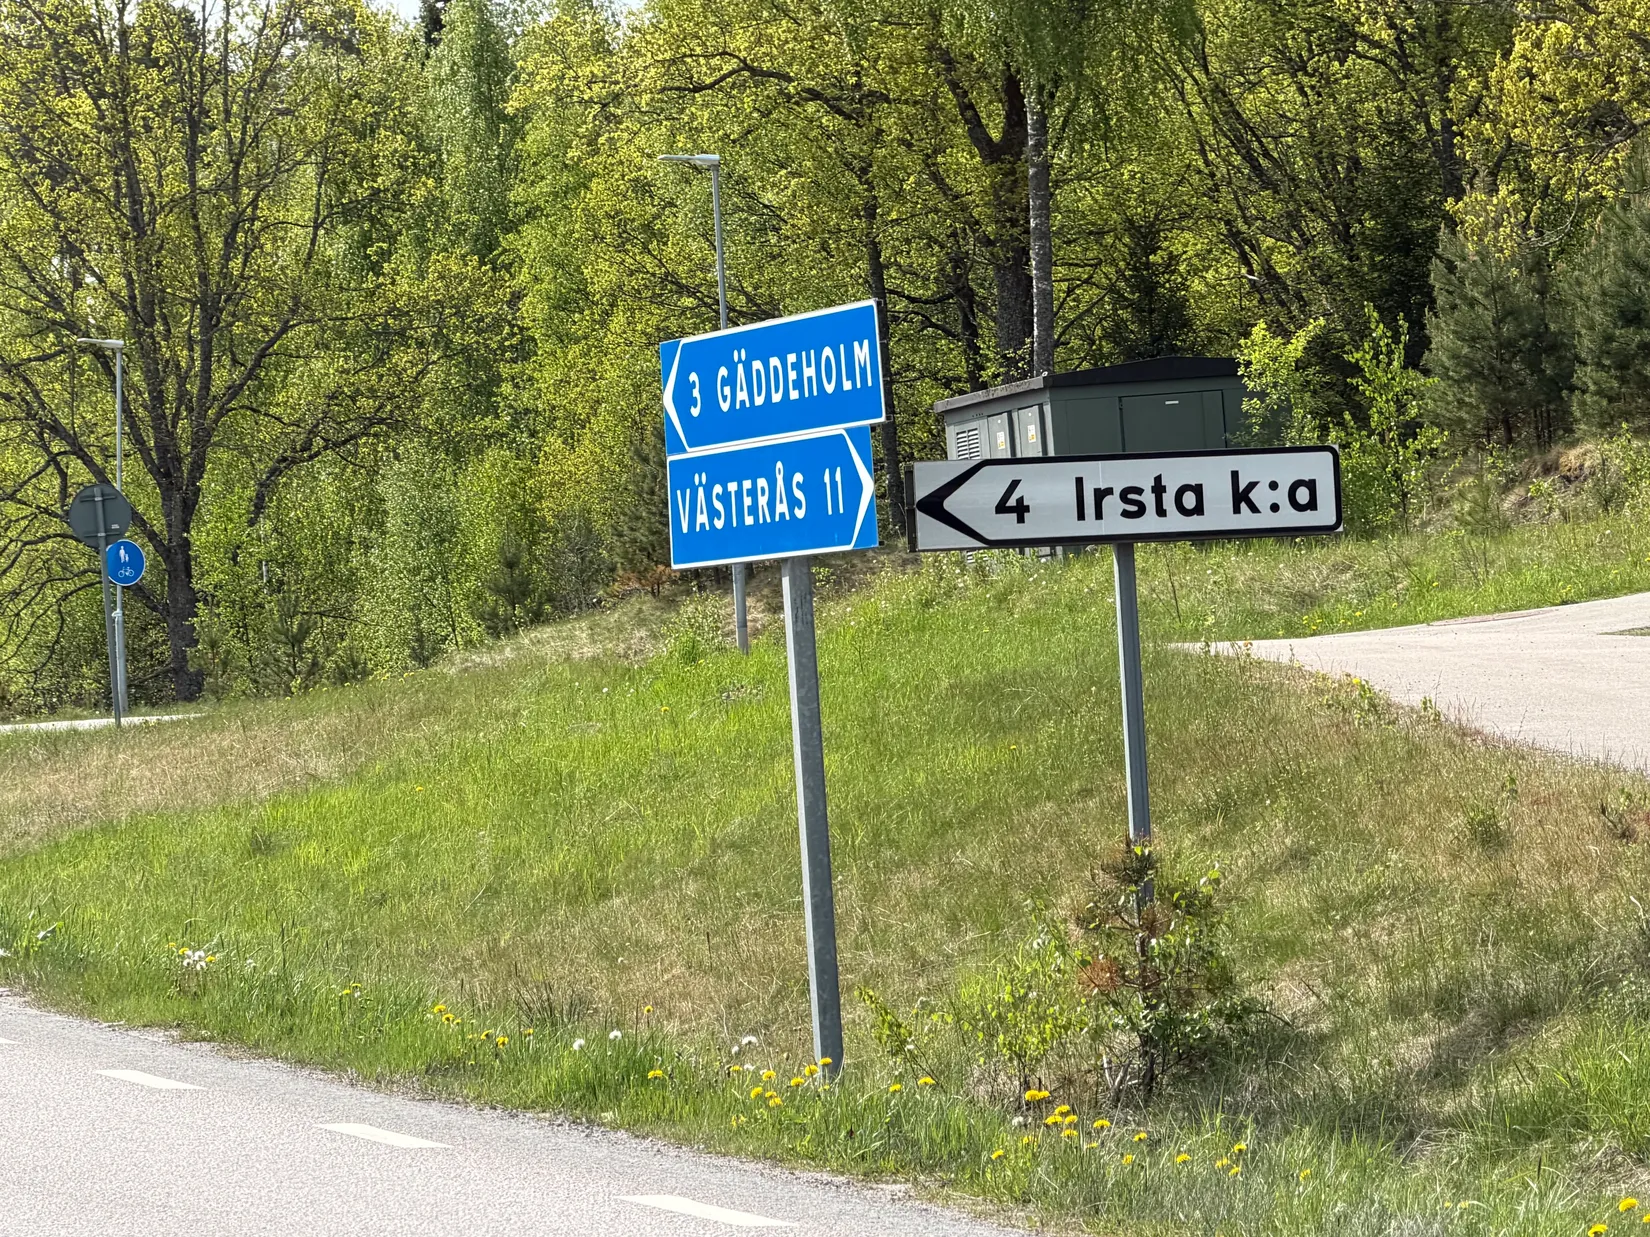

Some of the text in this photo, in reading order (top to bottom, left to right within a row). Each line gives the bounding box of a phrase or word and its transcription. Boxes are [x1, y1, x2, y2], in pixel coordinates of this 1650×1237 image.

[688, 339, 872, 417] 3 GÄDDEHOLM
[677, 460, 844, 534] VÄSTERÅS 11
[994, 470, 1319, 524] 4 Irsta k:a
